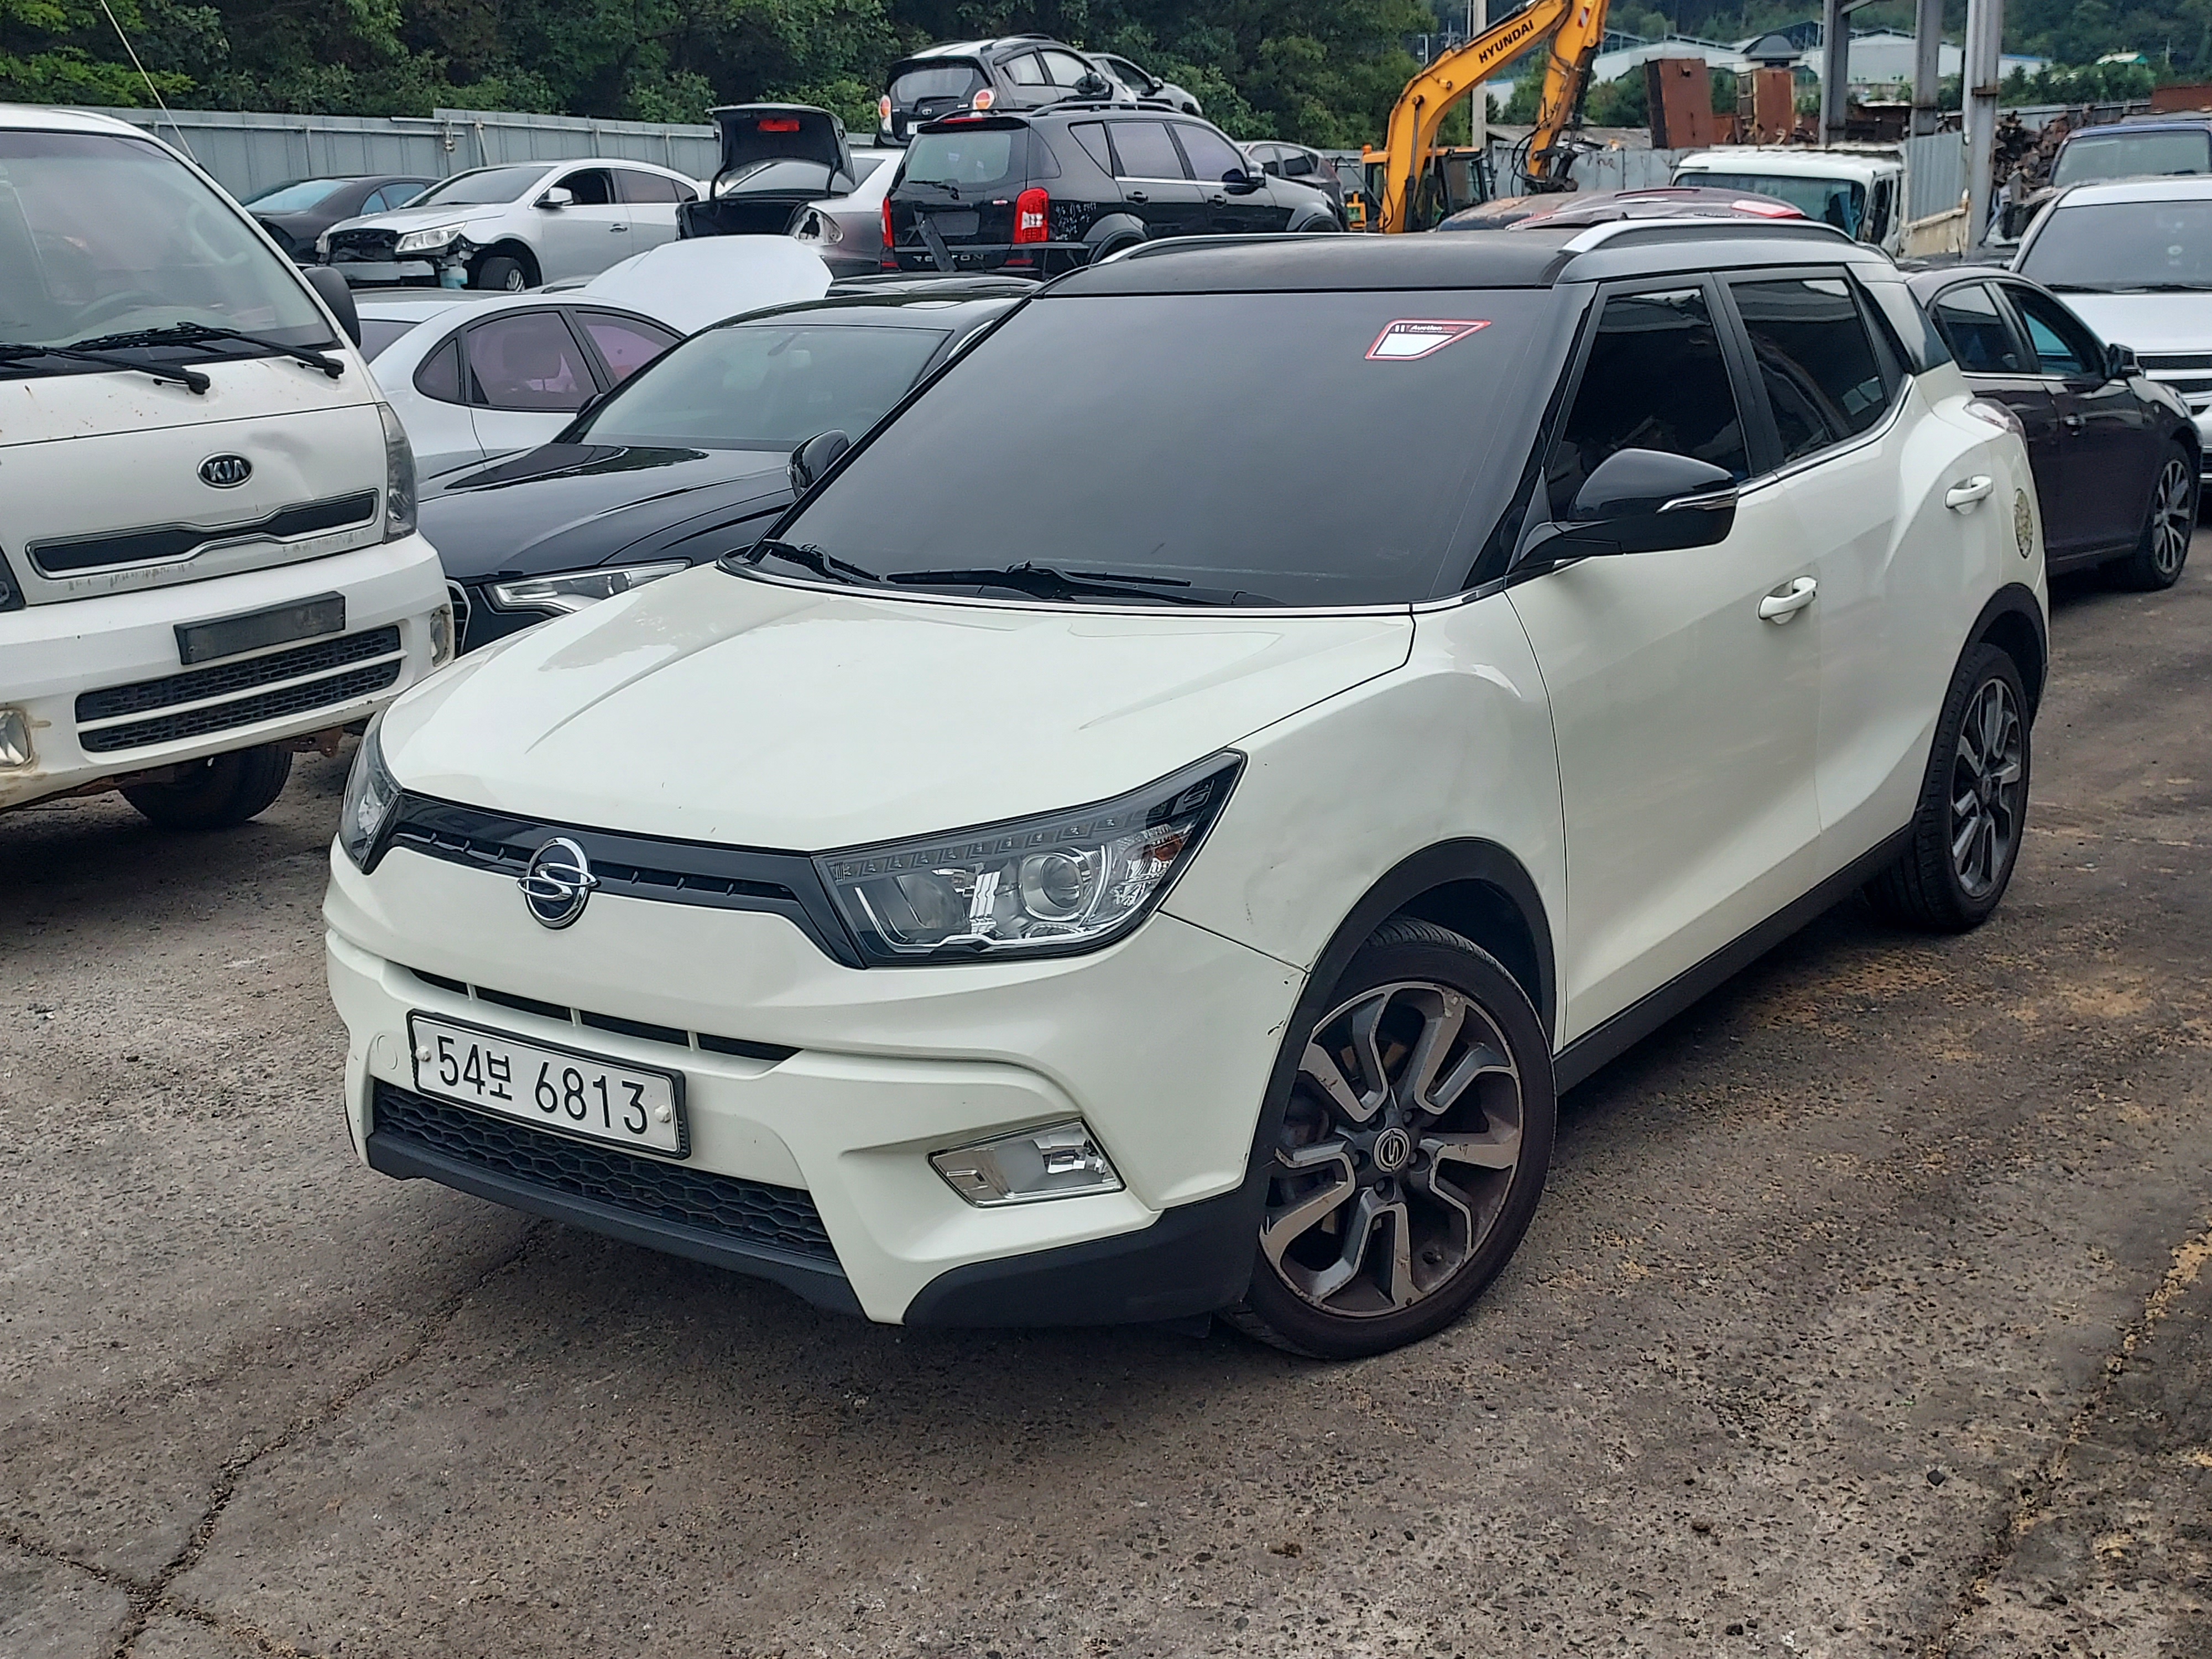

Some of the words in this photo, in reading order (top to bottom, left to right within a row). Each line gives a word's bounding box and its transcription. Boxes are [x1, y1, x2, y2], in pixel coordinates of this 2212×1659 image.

[1478, 19, 1535, 64] HYUNDAI
[912, 254, 985, 263] RETON
[206, 459, 247, 482] KIA
[437, 1035, 513, 1101] 54보
[534, 1061, 648, 1134] 6813
